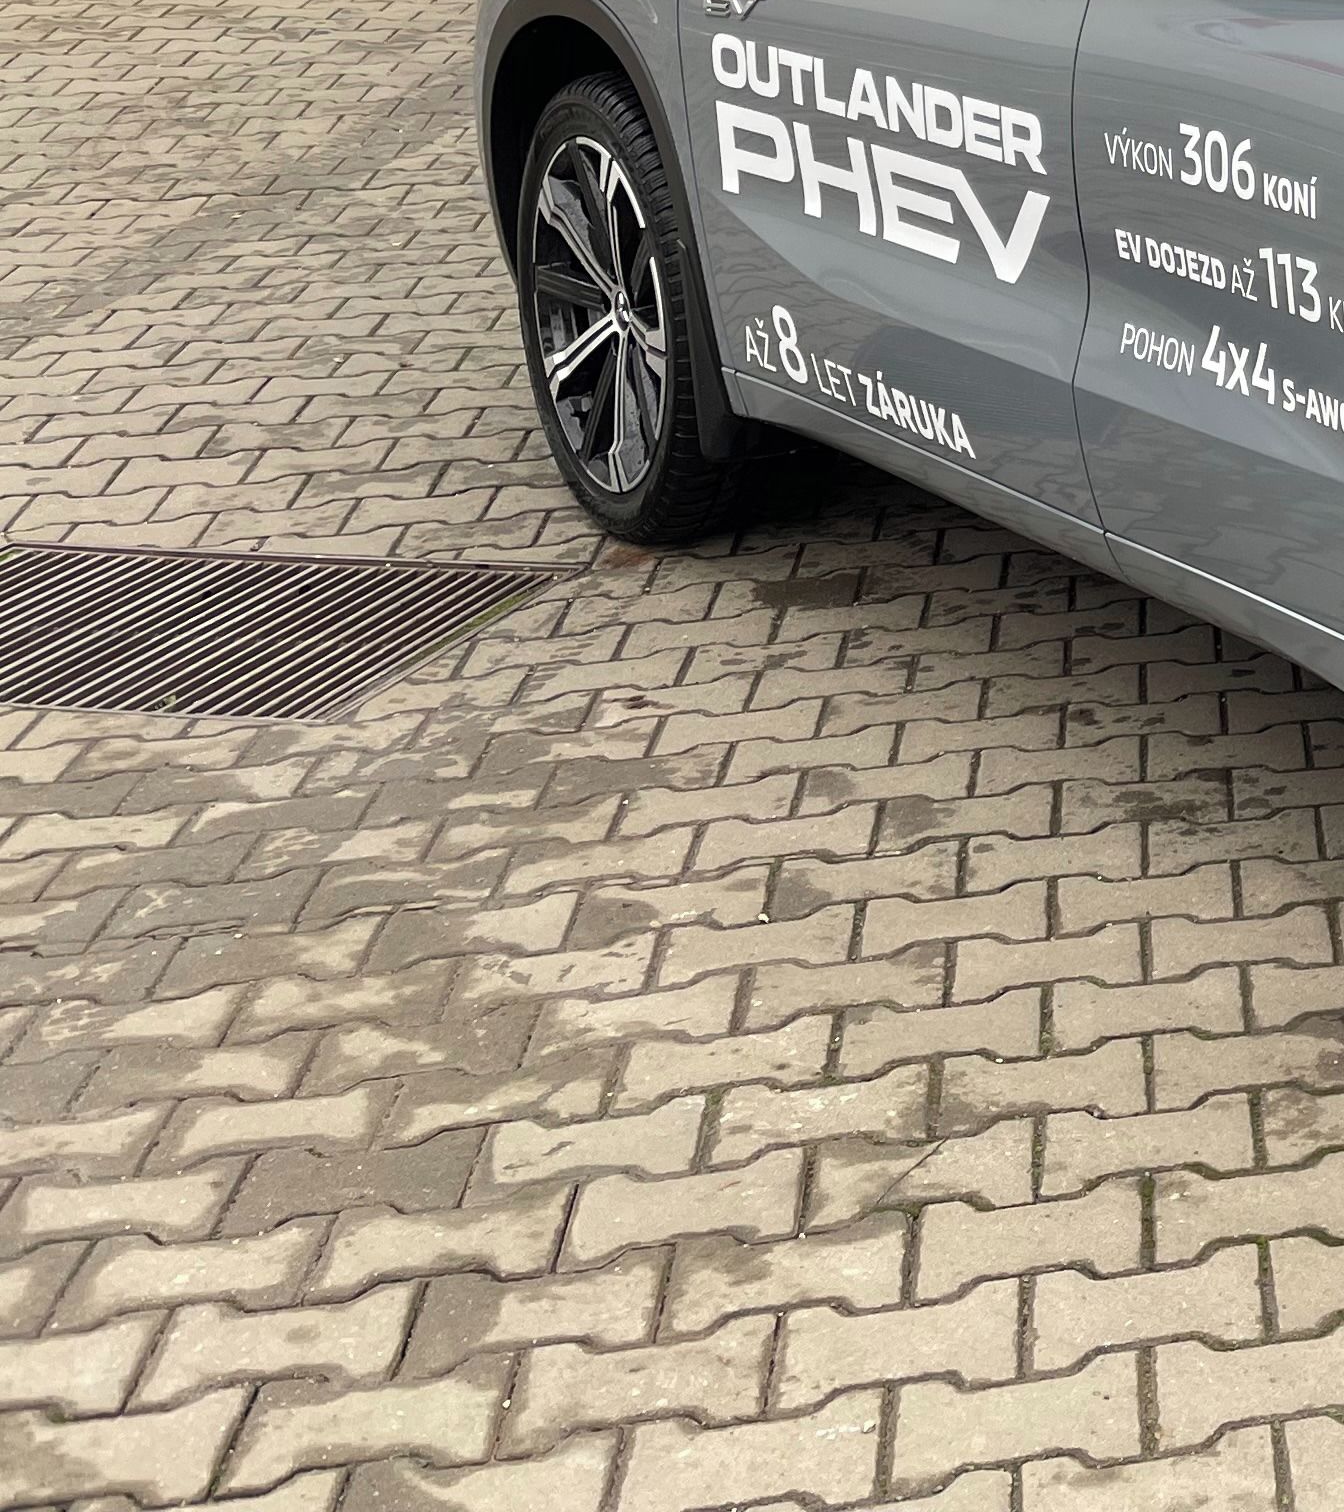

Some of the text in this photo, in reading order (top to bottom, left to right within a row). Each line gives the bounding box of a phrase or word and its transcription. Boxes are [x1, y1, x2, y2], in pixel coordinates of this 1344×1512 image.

[711, 33, 1047, 175] OUTLANDER
[715, 99, 1051, 285] PHEV
[1103, 122, 1318, 220] VÝKON 306 KONÍ
[1114, 228, 1141, 262] EV
[1144, 236, 1226, 291] DOJEZD
[1230, 259, 1258, 302] AŽ
[1258, 247, 1321, 324] 113
[744, 304, 977, 459] AŽ 8 LET ZÁRUKA
[1120, 322, 1195, 376] POHON
